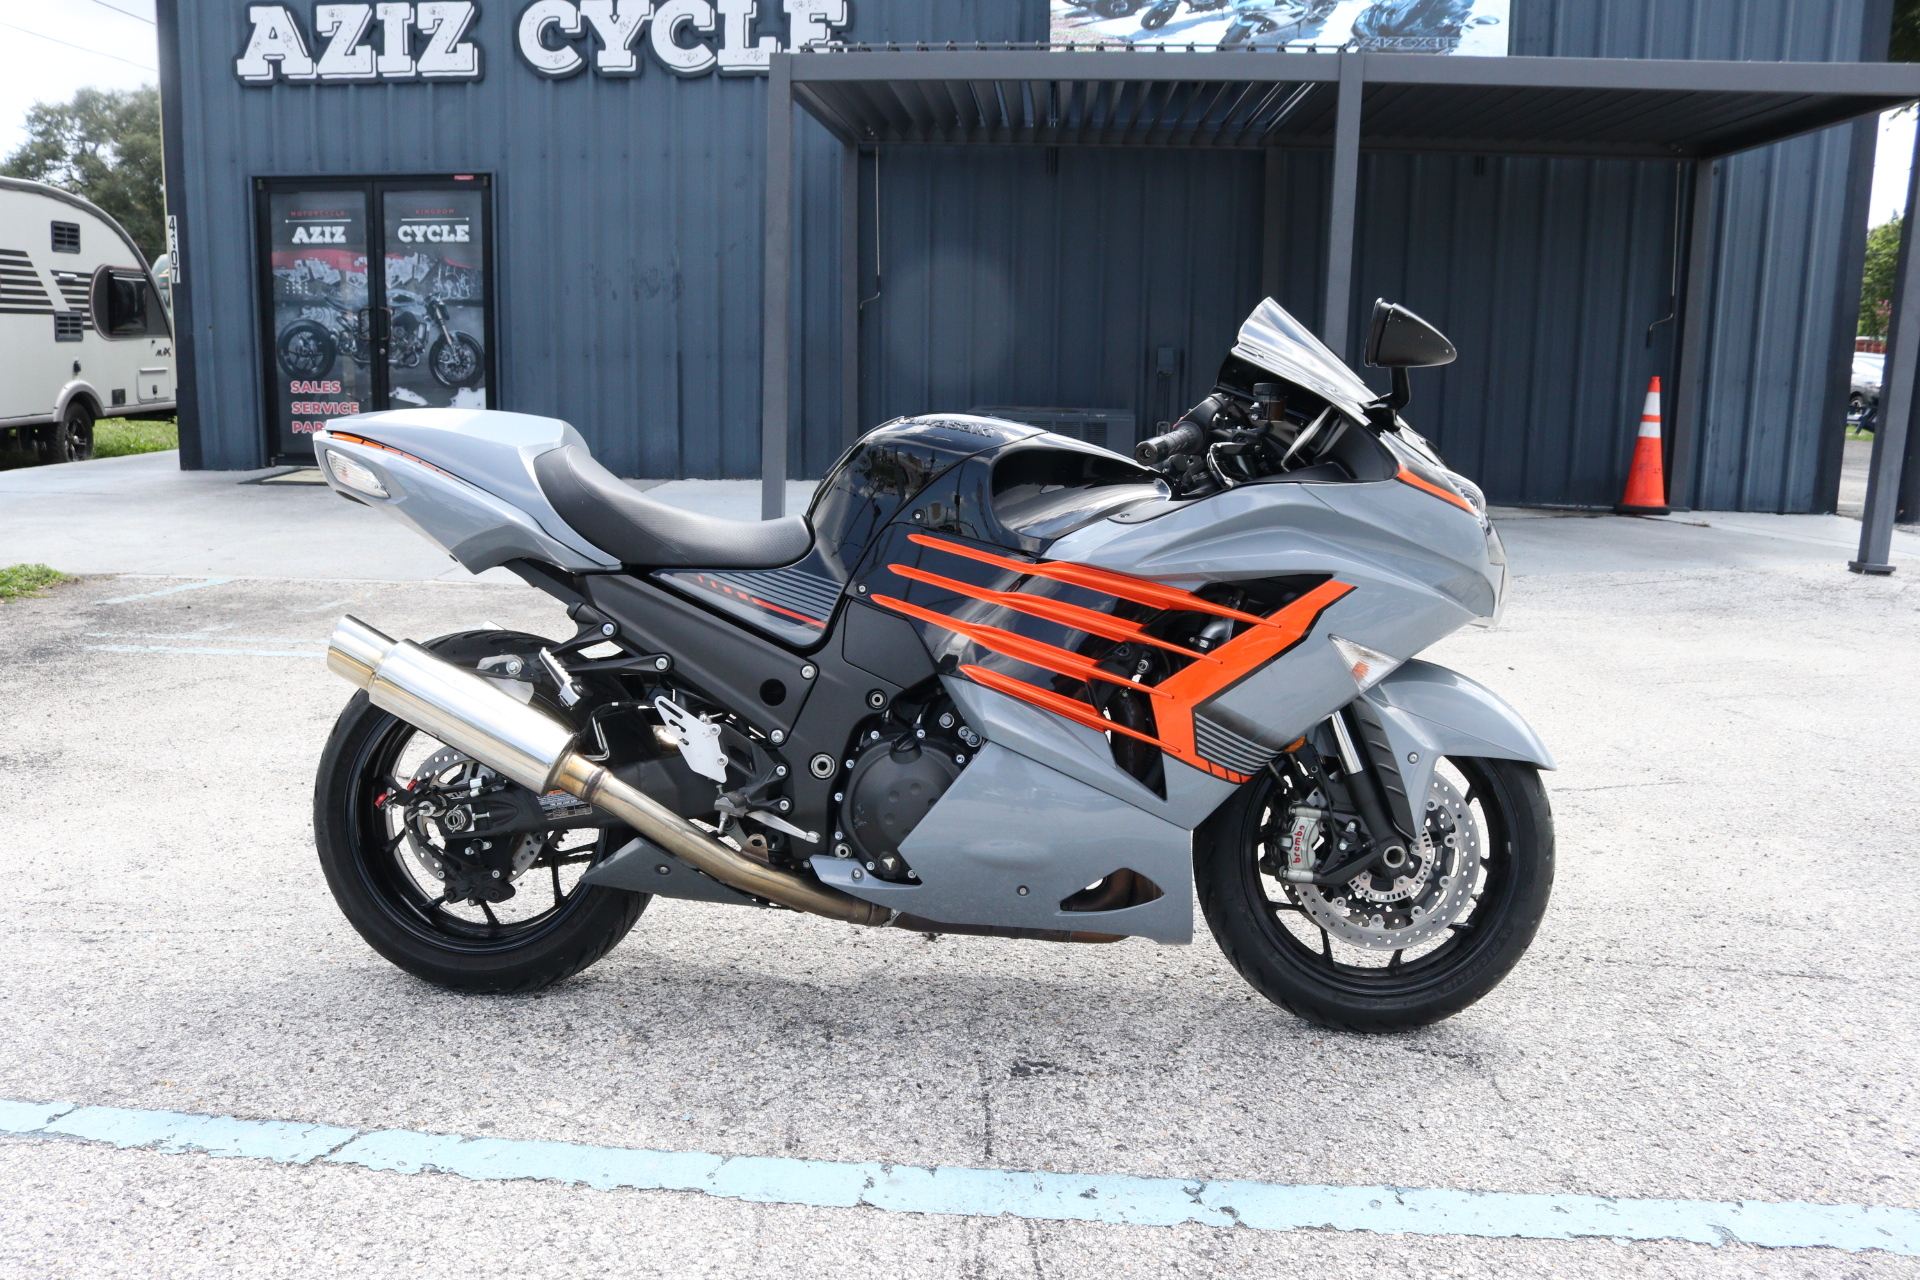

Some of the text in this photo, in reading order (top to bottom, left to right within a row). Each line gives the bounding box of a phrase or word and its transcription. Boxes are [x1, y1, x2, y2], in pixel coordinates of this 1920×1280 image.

[237, 0, 848, 80] AZIZ CYCLE
[292, 226, 347, 244] AZIZ
[398, 225, 470, 243] CYCLE
[290, 381, 341, 393] SALES
[291, 402, 360, 414] SERVICE
[292, 421, 325, 433] PAR
[1293, 825, 1306, 864] brembo
